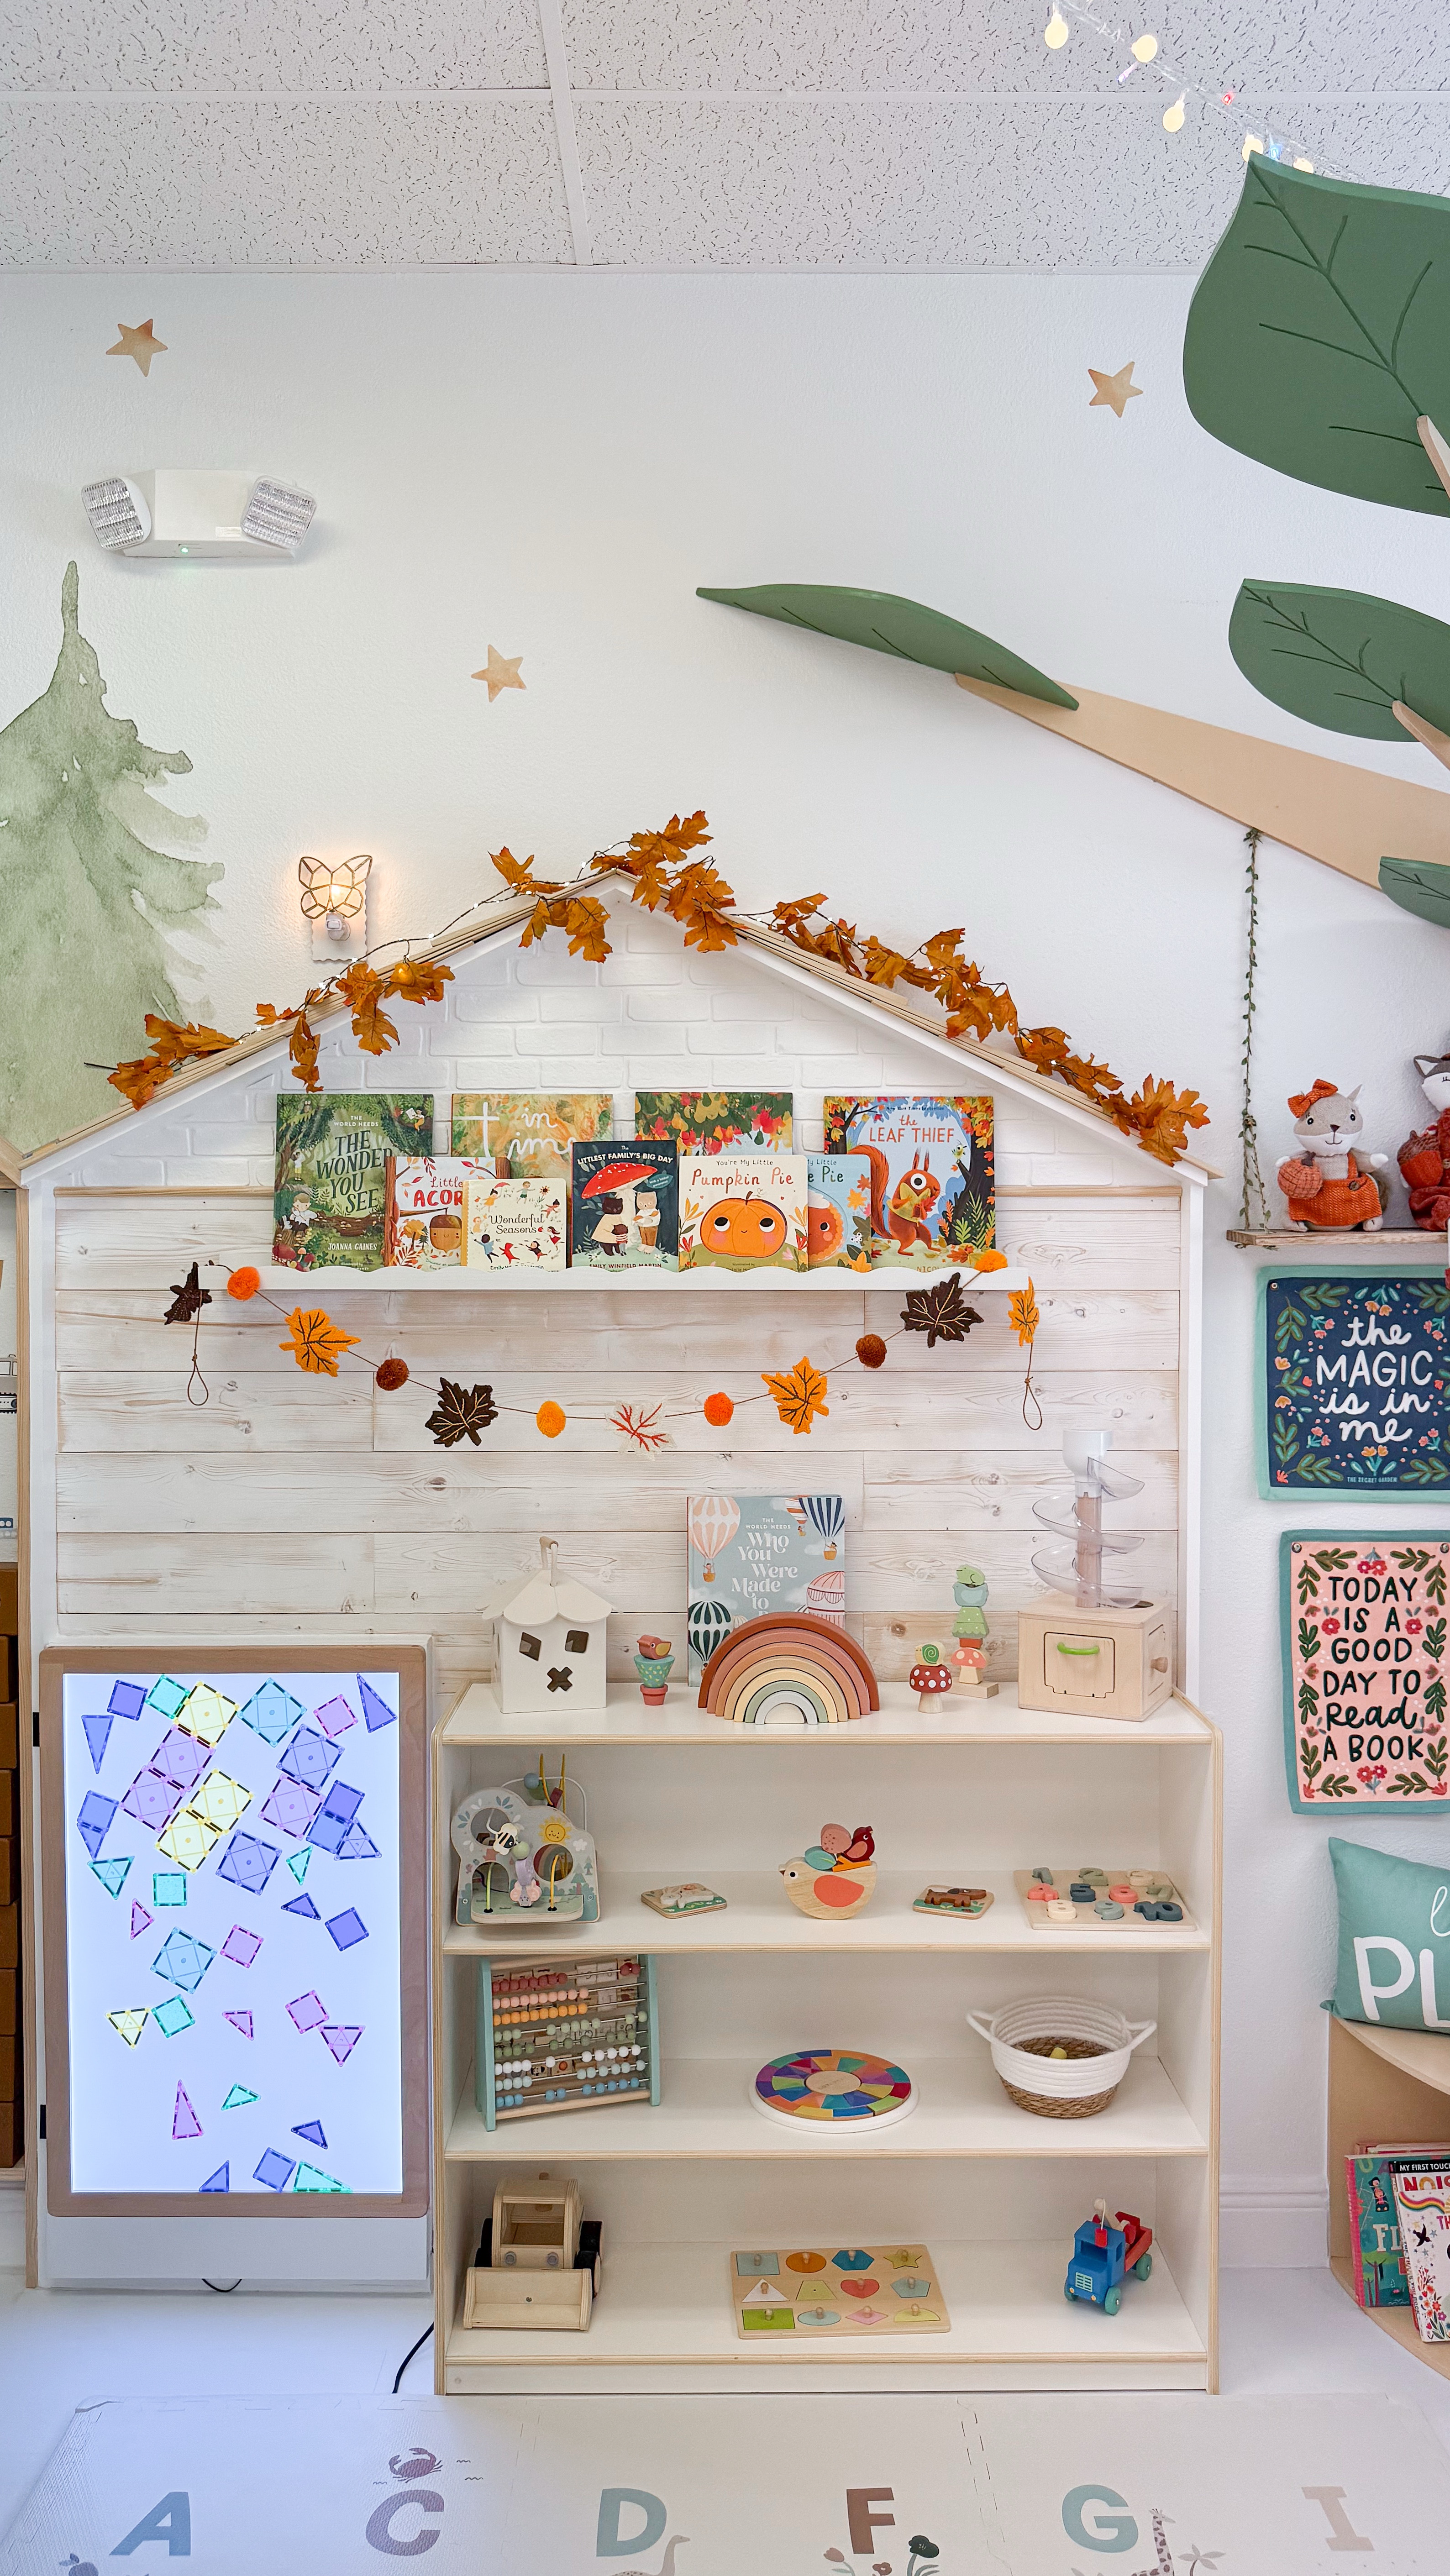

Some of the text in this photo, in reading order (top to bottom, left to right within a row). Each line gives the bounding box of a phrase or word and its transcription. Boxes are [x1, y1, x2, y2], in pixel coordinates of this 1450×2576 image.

[521, 1107, 557, 1128] in
[899, 1114, 918, 1126] the
[335, 1130, 371, 1156] THE
[869, 1128, 954, 1143] LEAF THIEF
[577, 1154, 606, 1165] LITTLEST
[657, 1155, 673, 1164] DAY
[330, 1172, 365, 1199] YOU
[431, 1176, 463, 1187] Little
[692, 1167, 793, 1194] Pumpkin Pie
[822, 1166, 844, 1182] Pie
[346, 1189, 379, 1213] SEE
[489, 1213, 545, 1227] Wonderful
[496, 1225, 537, 1234] Seasons
[1341, 1314, 1412, 1347] the
[1316, 1349, 1433, 1388] MAGIC
[1319, 1387, 1430, 1416] is in
[1339, 1418, 1413, 1444] me
[738, 1546, 771, 1561] You
[747, 1532, 789, 1553] Who
[751, 1563, 798, 1578] Were
[731, 1578, 781, 1598] Made
[1328, 1576, 1418, 1604] TODAY
[752, 1597, 769, 1610] to
[1344, 1606, 1400, 1633] IS A
[1331, 1637, 1413, 1664] GOOD
[1324, 1669, 1421, 1697] DAY TO
[1326, 1696, 1417, 1731] Read
[1323, 1734, 1424, 1762] A BOOK
[1079, 1868, 1109, 1886] 2
[1028, 1883, 1059, 1902] 4
[1070, 1883, 1096, 1902] 5
[1109, 1883, 1138, 1903] 6
[1047, 1899, 1183, 1921] 8 9 10
[109, 2492, 190, 2556] A
[365, 2489, 444, 2556] C
[596, 2488, 667, 2557] D
[846, 2487, 895, 2555] F
[1062, 2484, 1139, 2554] G
[1302, 2486, 1374, 2551] I
